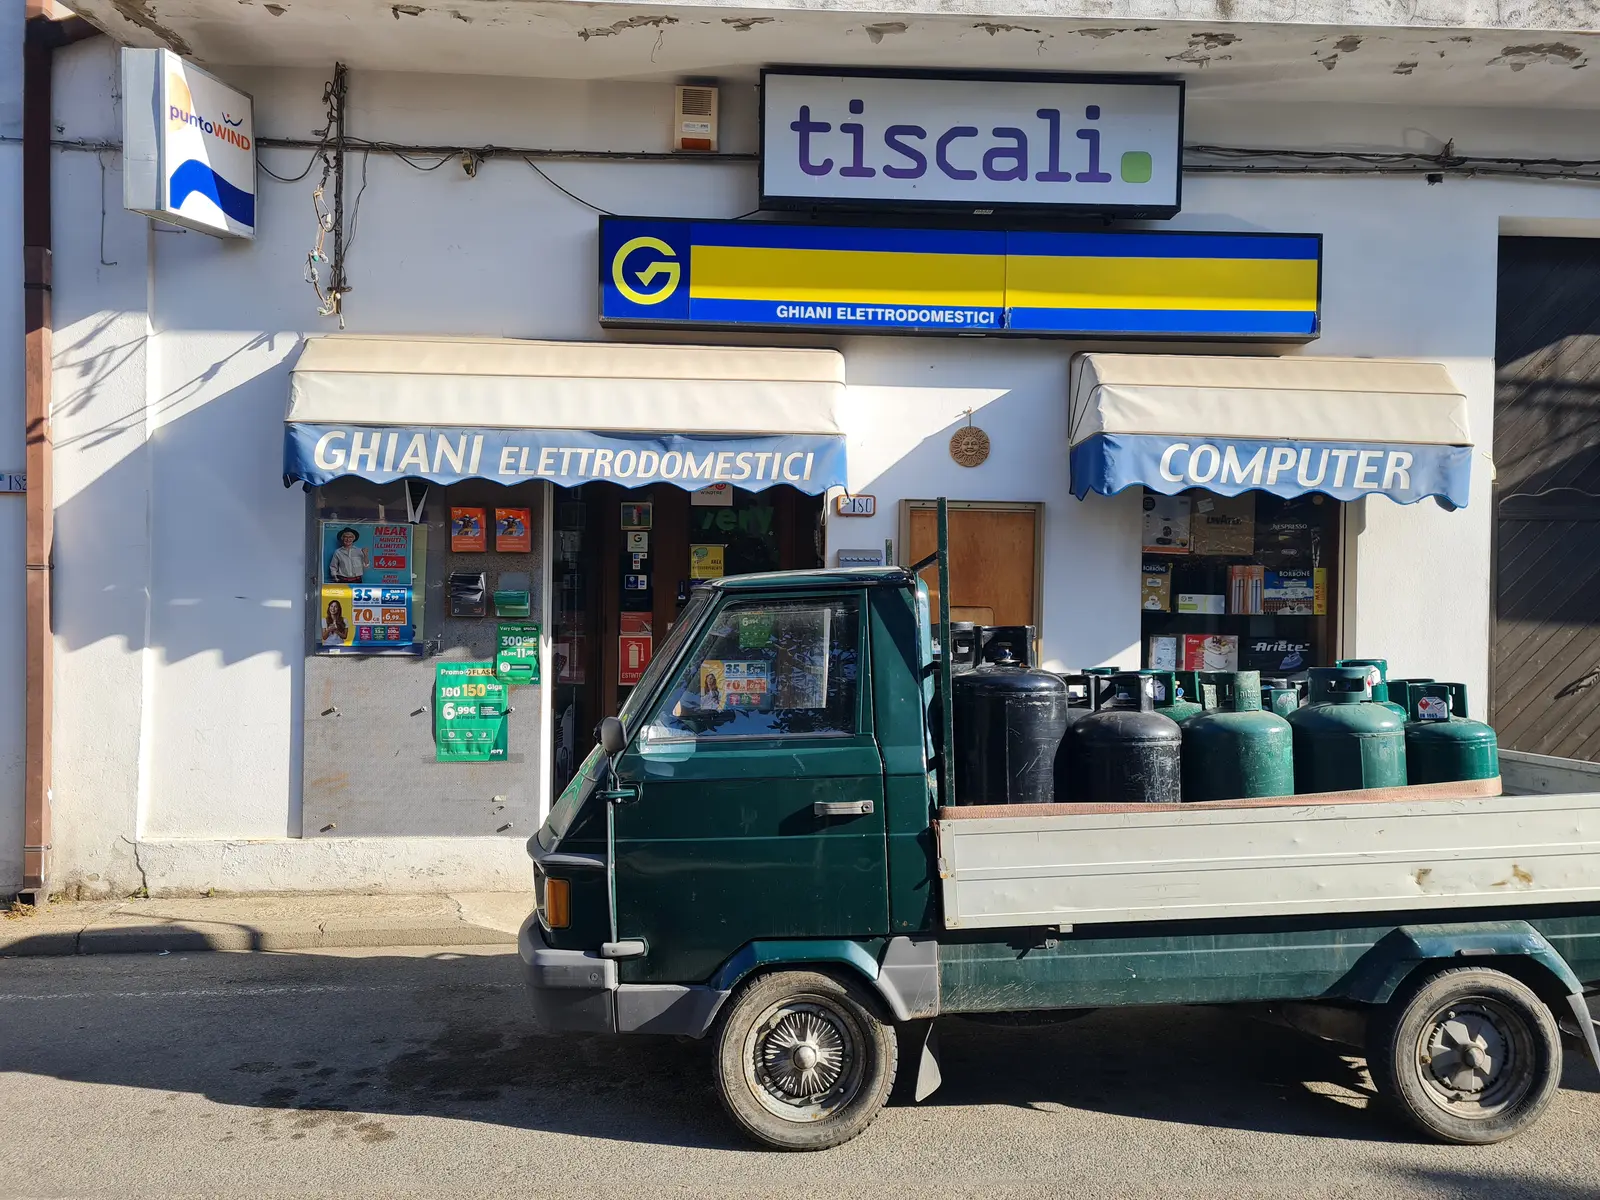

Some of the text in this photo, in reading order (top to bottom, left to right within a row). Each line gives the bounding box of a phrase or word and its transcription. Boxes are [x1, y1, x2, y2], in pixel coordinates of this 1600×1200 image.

[170, 104, 251, 151] puntoWIND
[776, 305, 995, 324] GHIANI ELETTRODOMESTICI
[313, 430, 815, 482] GHIANI ELETTRODOMESTICI
[1158, 443, 1414, 490] COMPUTER
[852, 497, 873, 513] 180
[374, 526, 407, 536] NEAR
[354, 589, 373, 602] 35
[354, 608, 373, 622] 70
[501, 636, 522, 646] 300
[1251, 641, 1311, 652] Ariete
[441, 668, 497, 676] Promo FLASH
[441, 687, 461, 698] 100
[462, 683, 486, 697] 150
[443, 702, 476, 720] 6,99€
